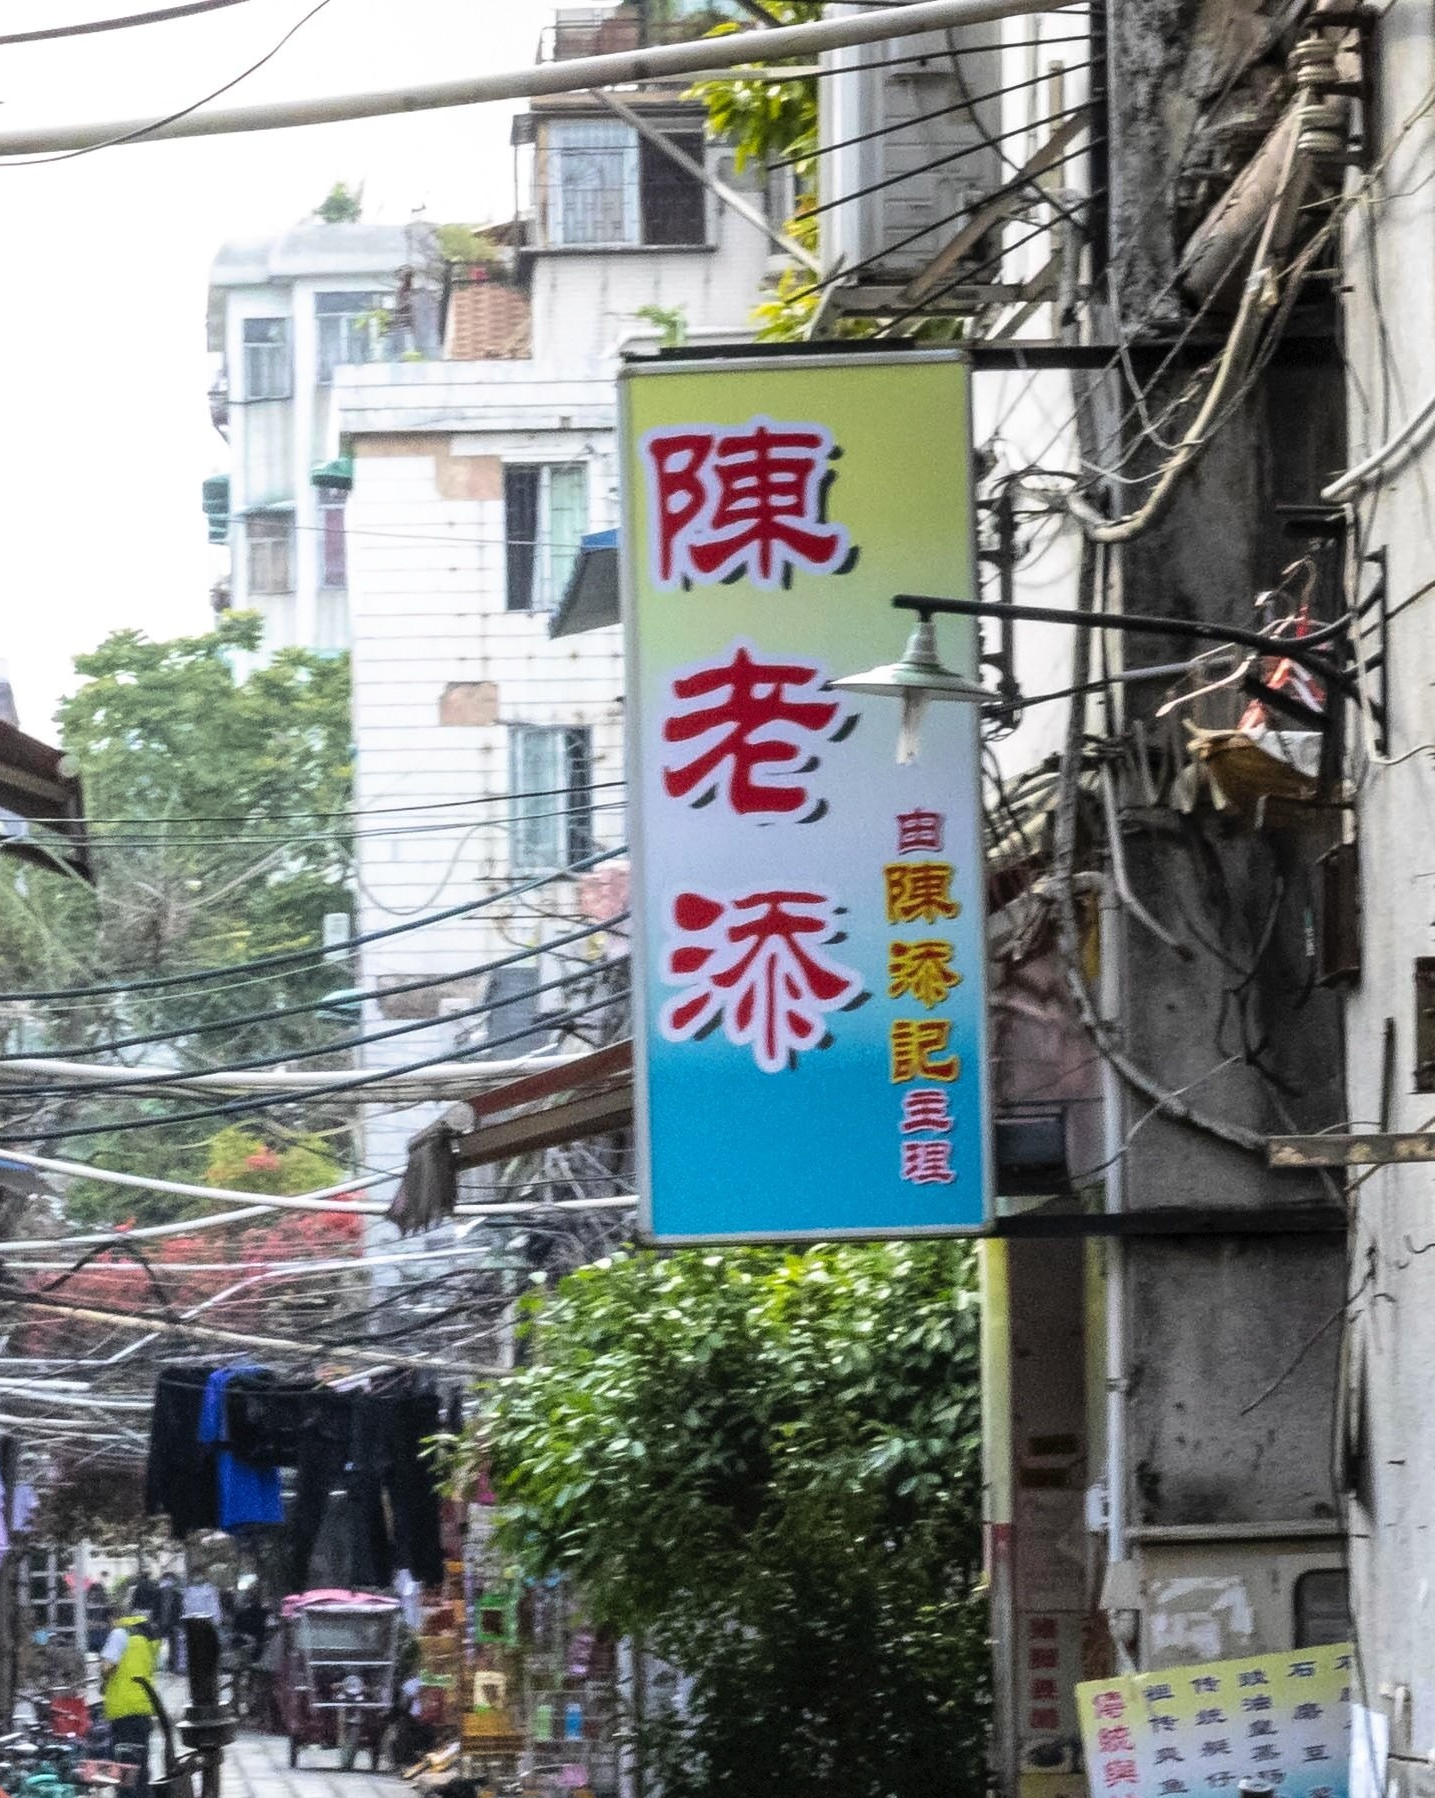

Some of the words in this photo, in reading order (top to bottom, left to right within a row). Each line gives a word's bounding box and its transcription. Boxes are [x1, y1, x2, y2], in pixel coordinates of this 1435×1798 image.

[642, 420, 860, 1072] 陳老添
[883, 808, 963, 1186] 由陳添記主理
